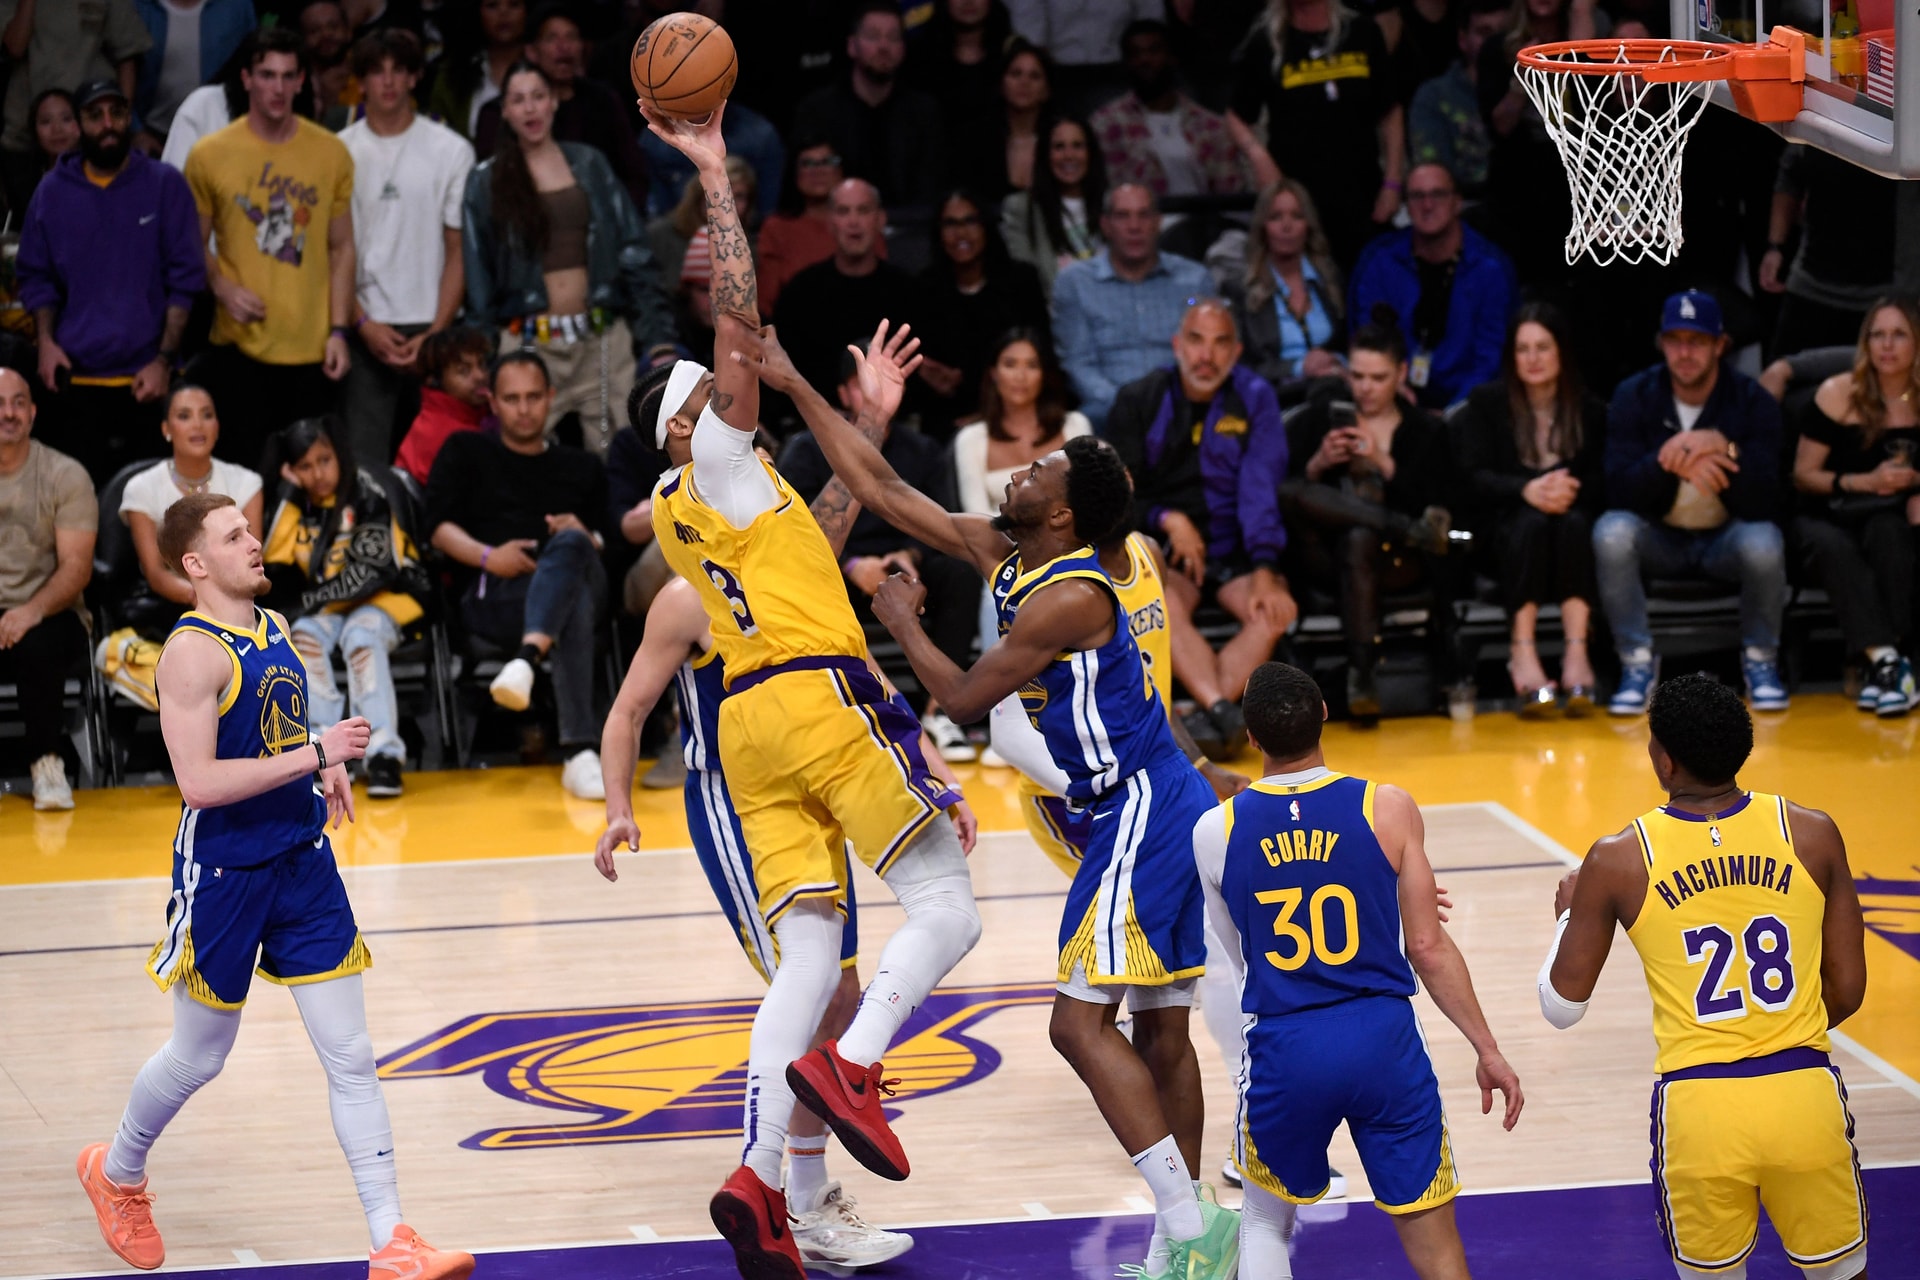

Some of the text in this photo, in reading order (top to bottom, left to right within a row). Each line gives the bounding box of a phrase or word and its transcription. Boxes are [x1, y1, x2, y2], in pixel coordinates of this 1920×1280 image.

[1002, 566, 1015, 581] 6
[700, 557, 760, 638] 3
[1128, 599, 1165, 637] KERS
[257, 665, 304, 698] GOLDEN STATE
[291, 693, 300, 717] 0
[1260, 829, 1340, 867] CURRY
[1654, 855, 1793, 910] HACHIMURA
[1254, 883, 1360, 971] 30
[1681, 914, 1797, 1023] 28
